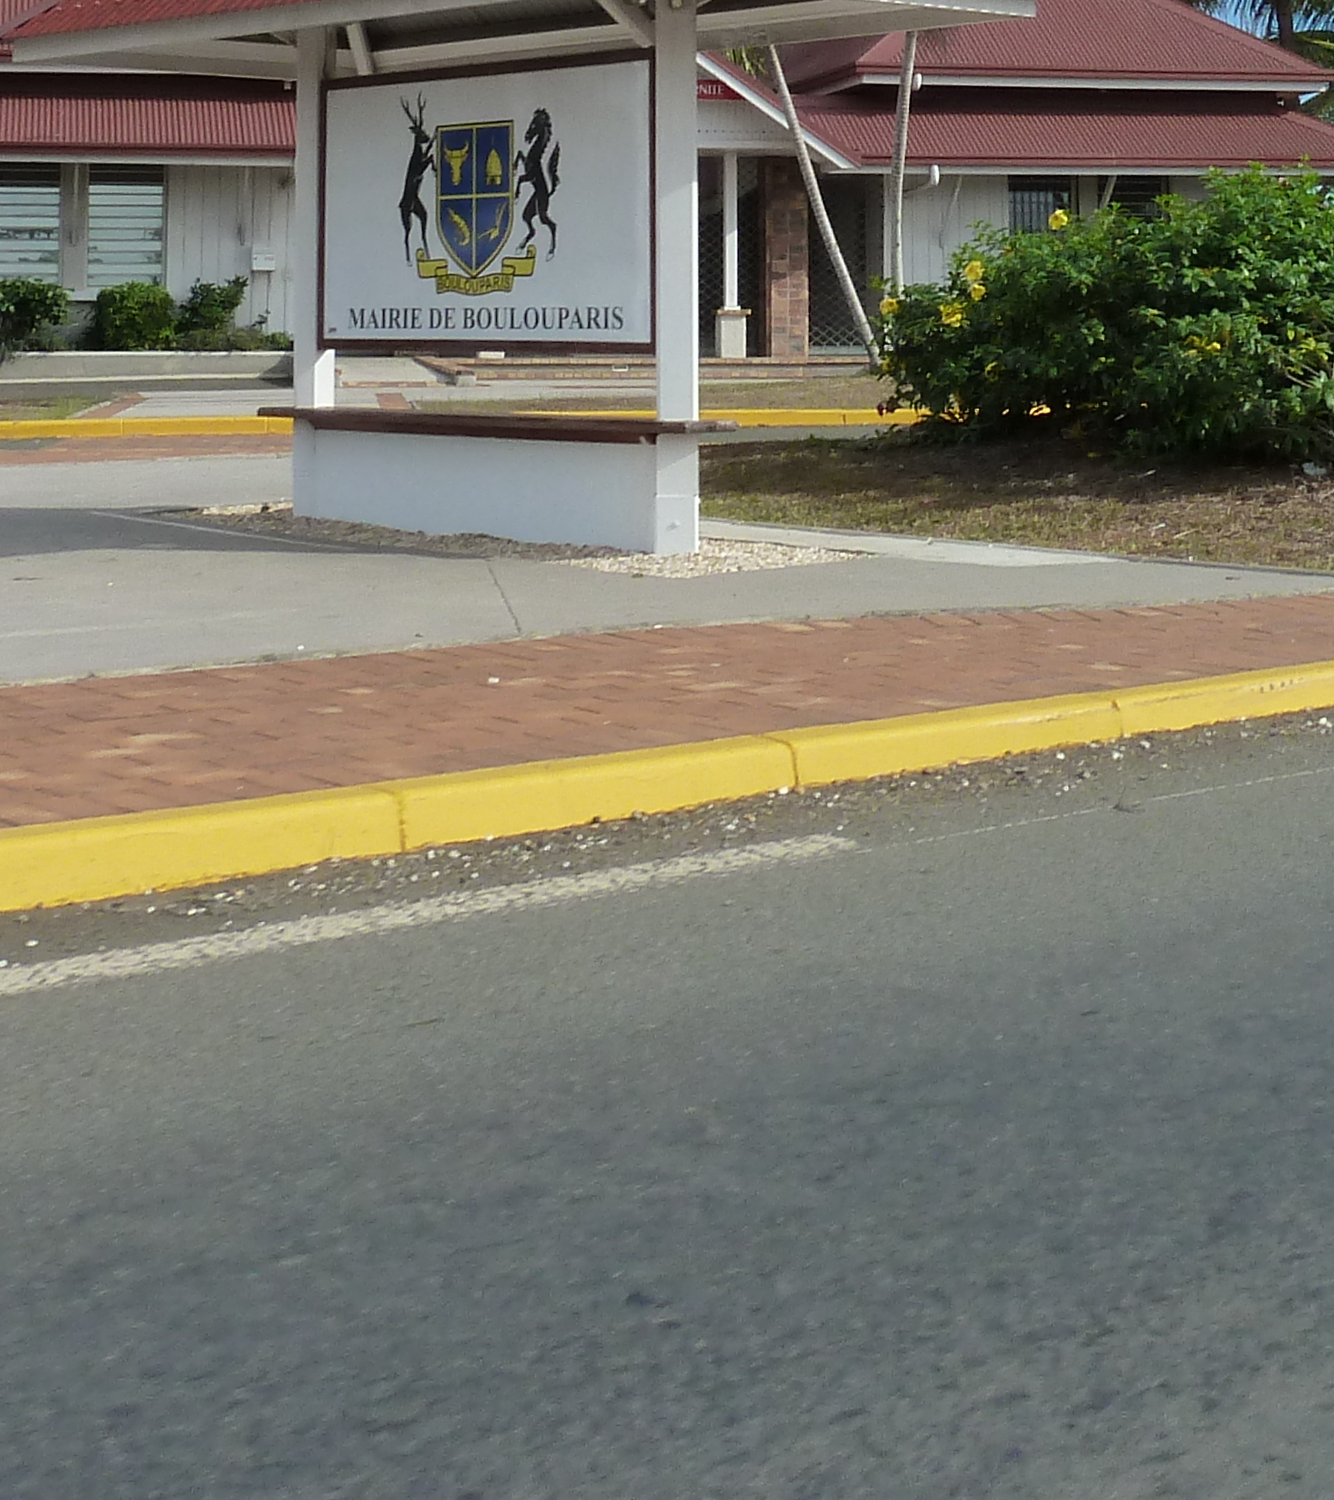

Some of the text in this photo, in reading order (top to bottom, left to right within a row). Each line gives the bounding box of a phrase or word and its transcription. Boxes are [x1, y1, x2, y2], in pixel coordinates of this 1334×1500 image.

[697, 84, 724, 95] NITE
[437, 274, 511, 293] BOULOUPARIS
[348, 306, 624, 331] MAIRIE DE BOULOUPARIS
